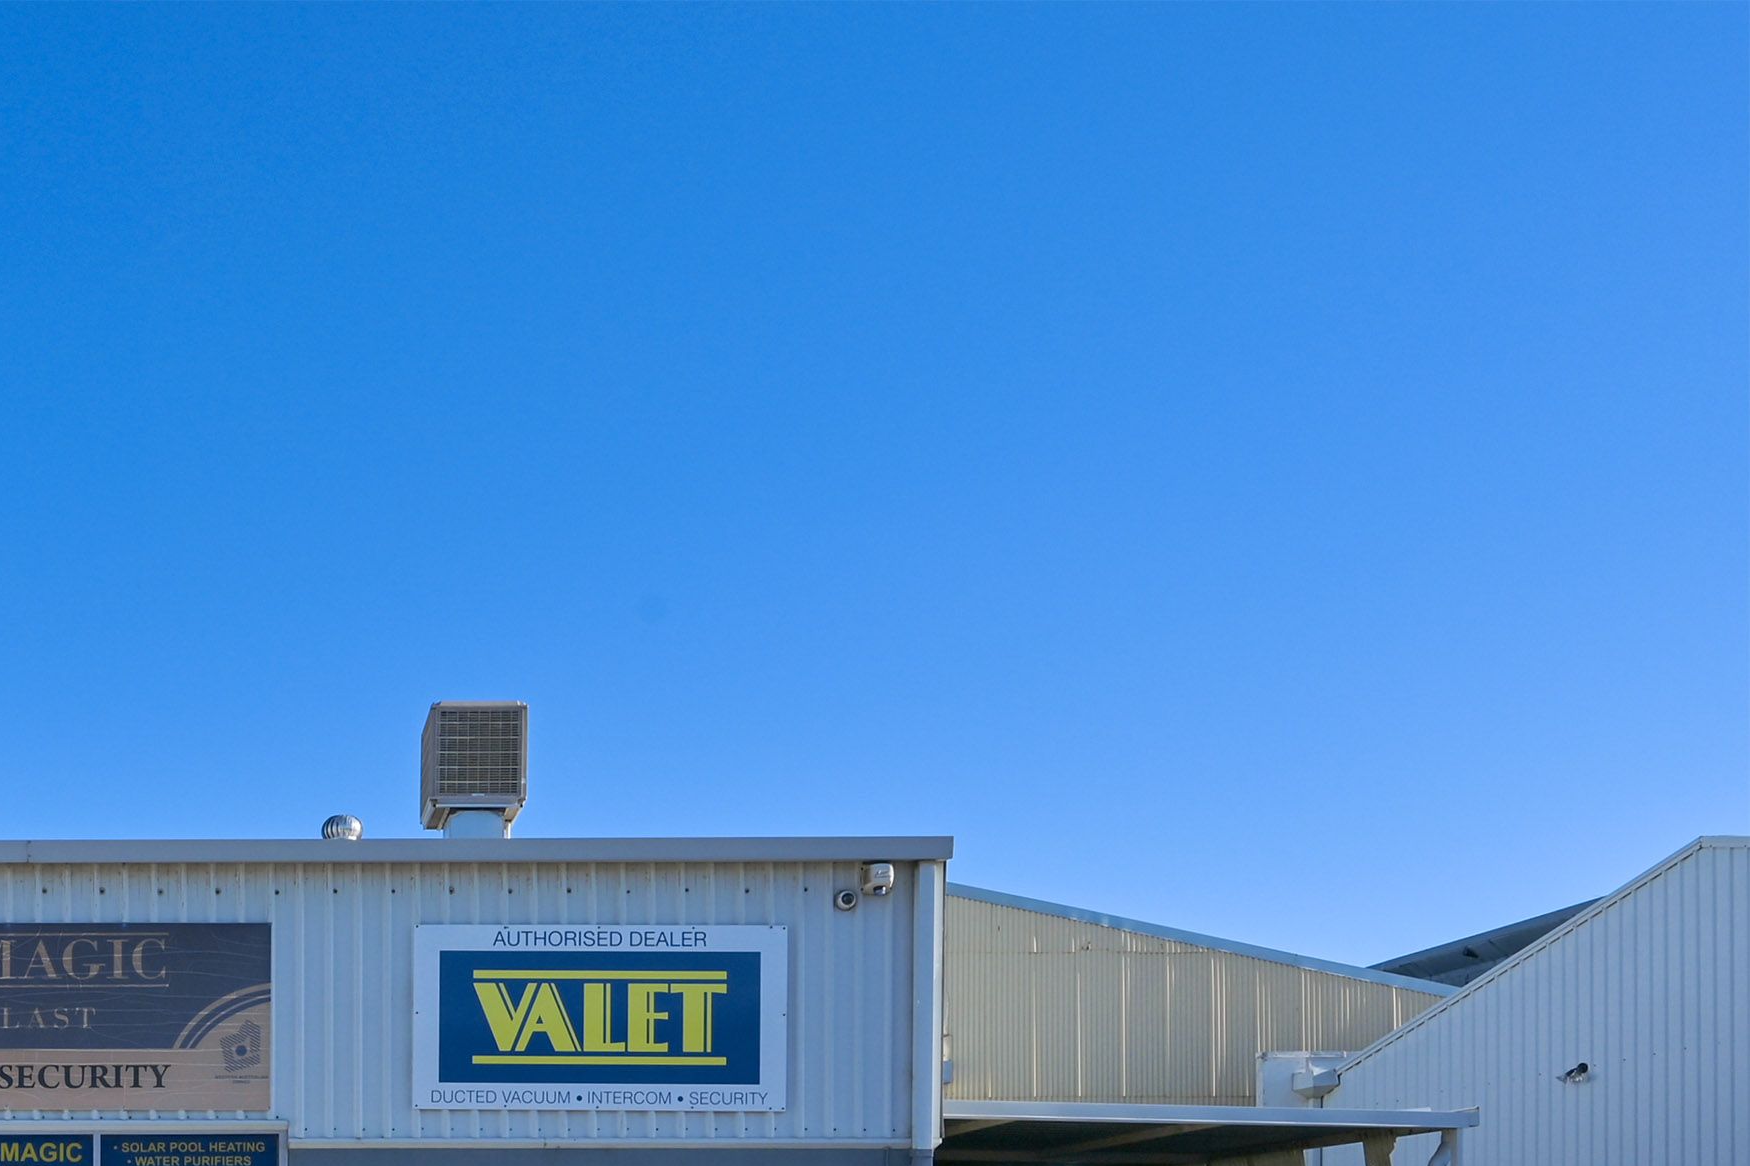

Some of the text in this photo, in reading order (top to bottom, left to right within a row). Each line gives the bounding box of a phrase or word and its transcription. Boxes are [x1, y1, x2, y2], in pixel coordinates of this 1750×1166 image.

[493, 931, 707, 947] AUTHORISED DEALER
[1, 1006, 96, 1029] LAST
[473, 982, 727, 1053] VALET
[431, 1090, 768, 1106] DUCTED VACUUM INTERCOM SECURITY
[122, 1142, 265, 1153] SOLAR POOL HEATING
[135, 1156, 251, 1166] WATER PURIFIERS
